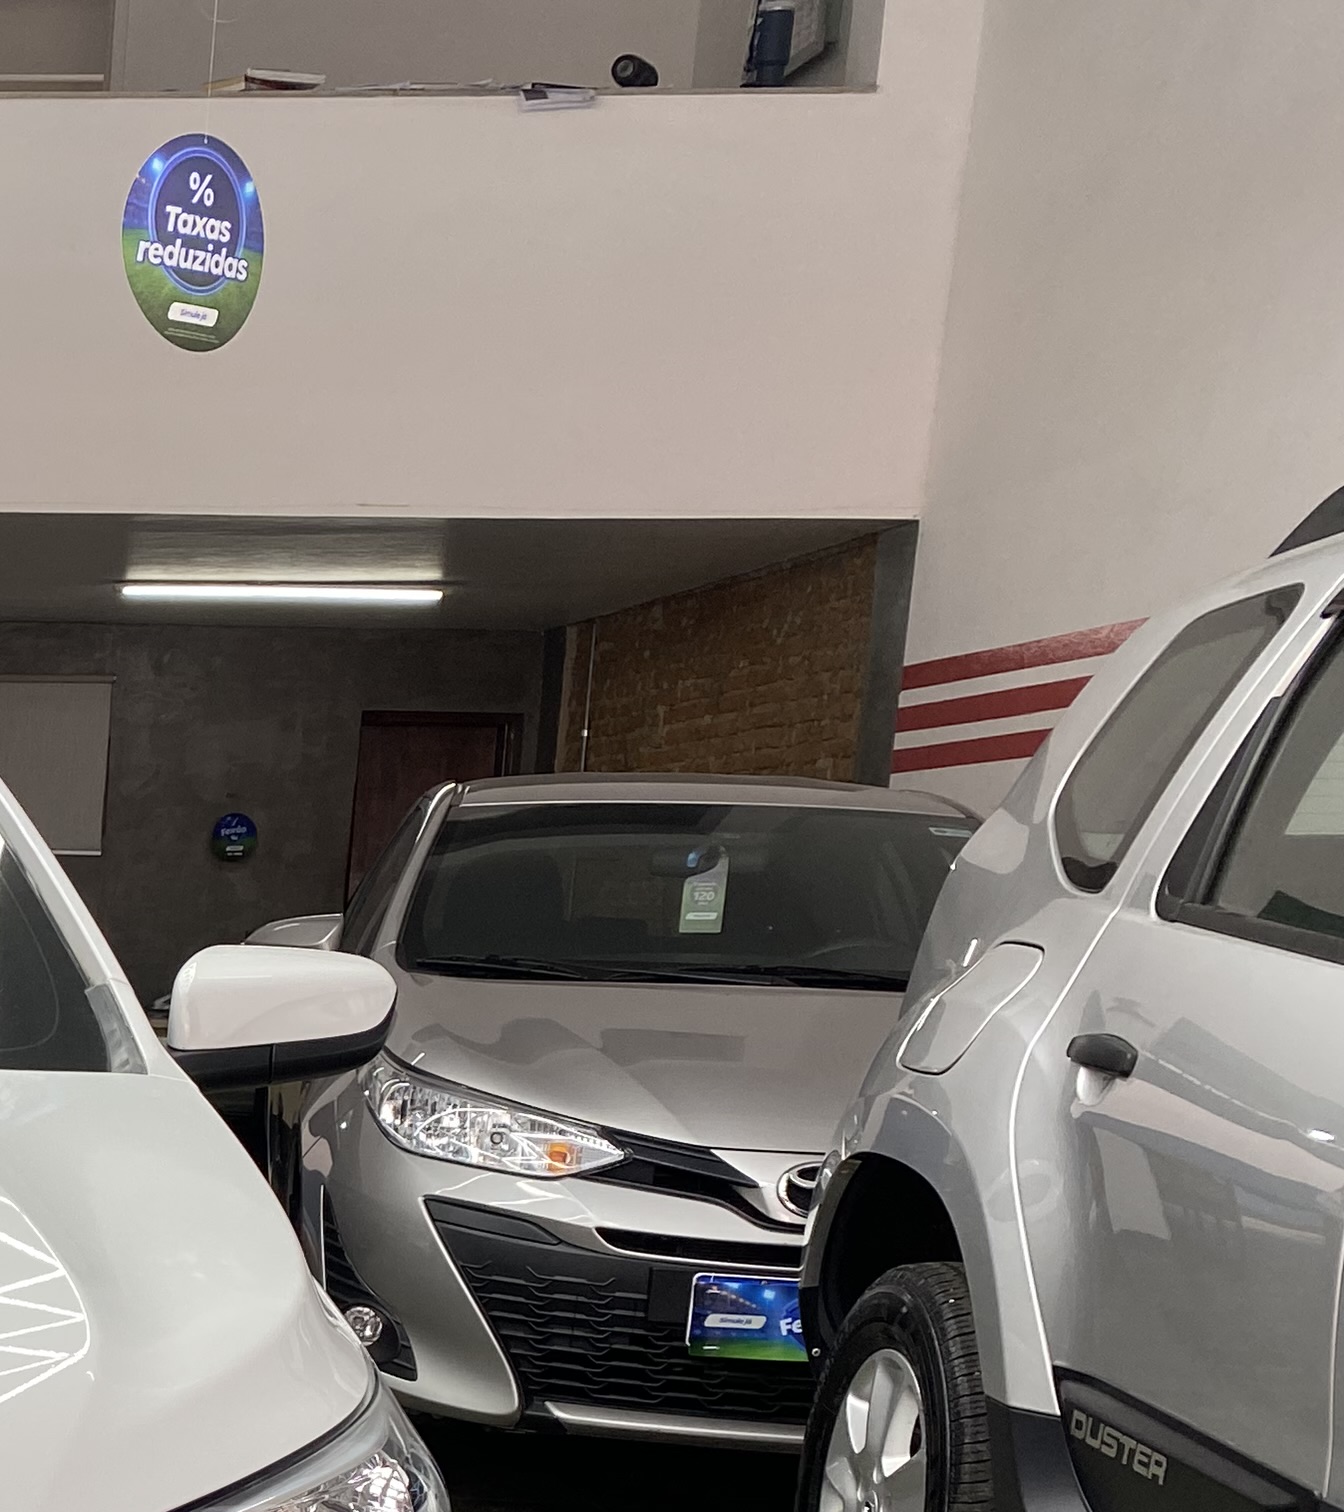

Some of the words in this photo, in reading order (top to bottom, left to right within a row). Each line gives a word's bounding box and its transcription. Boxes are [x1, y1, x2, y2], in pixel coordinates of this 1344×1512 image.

[165, 205, 232, 242] Taxas
[136, 238, 249, 281] reduzidas
[1069, 1409, 1167, 1485] DUSTER
